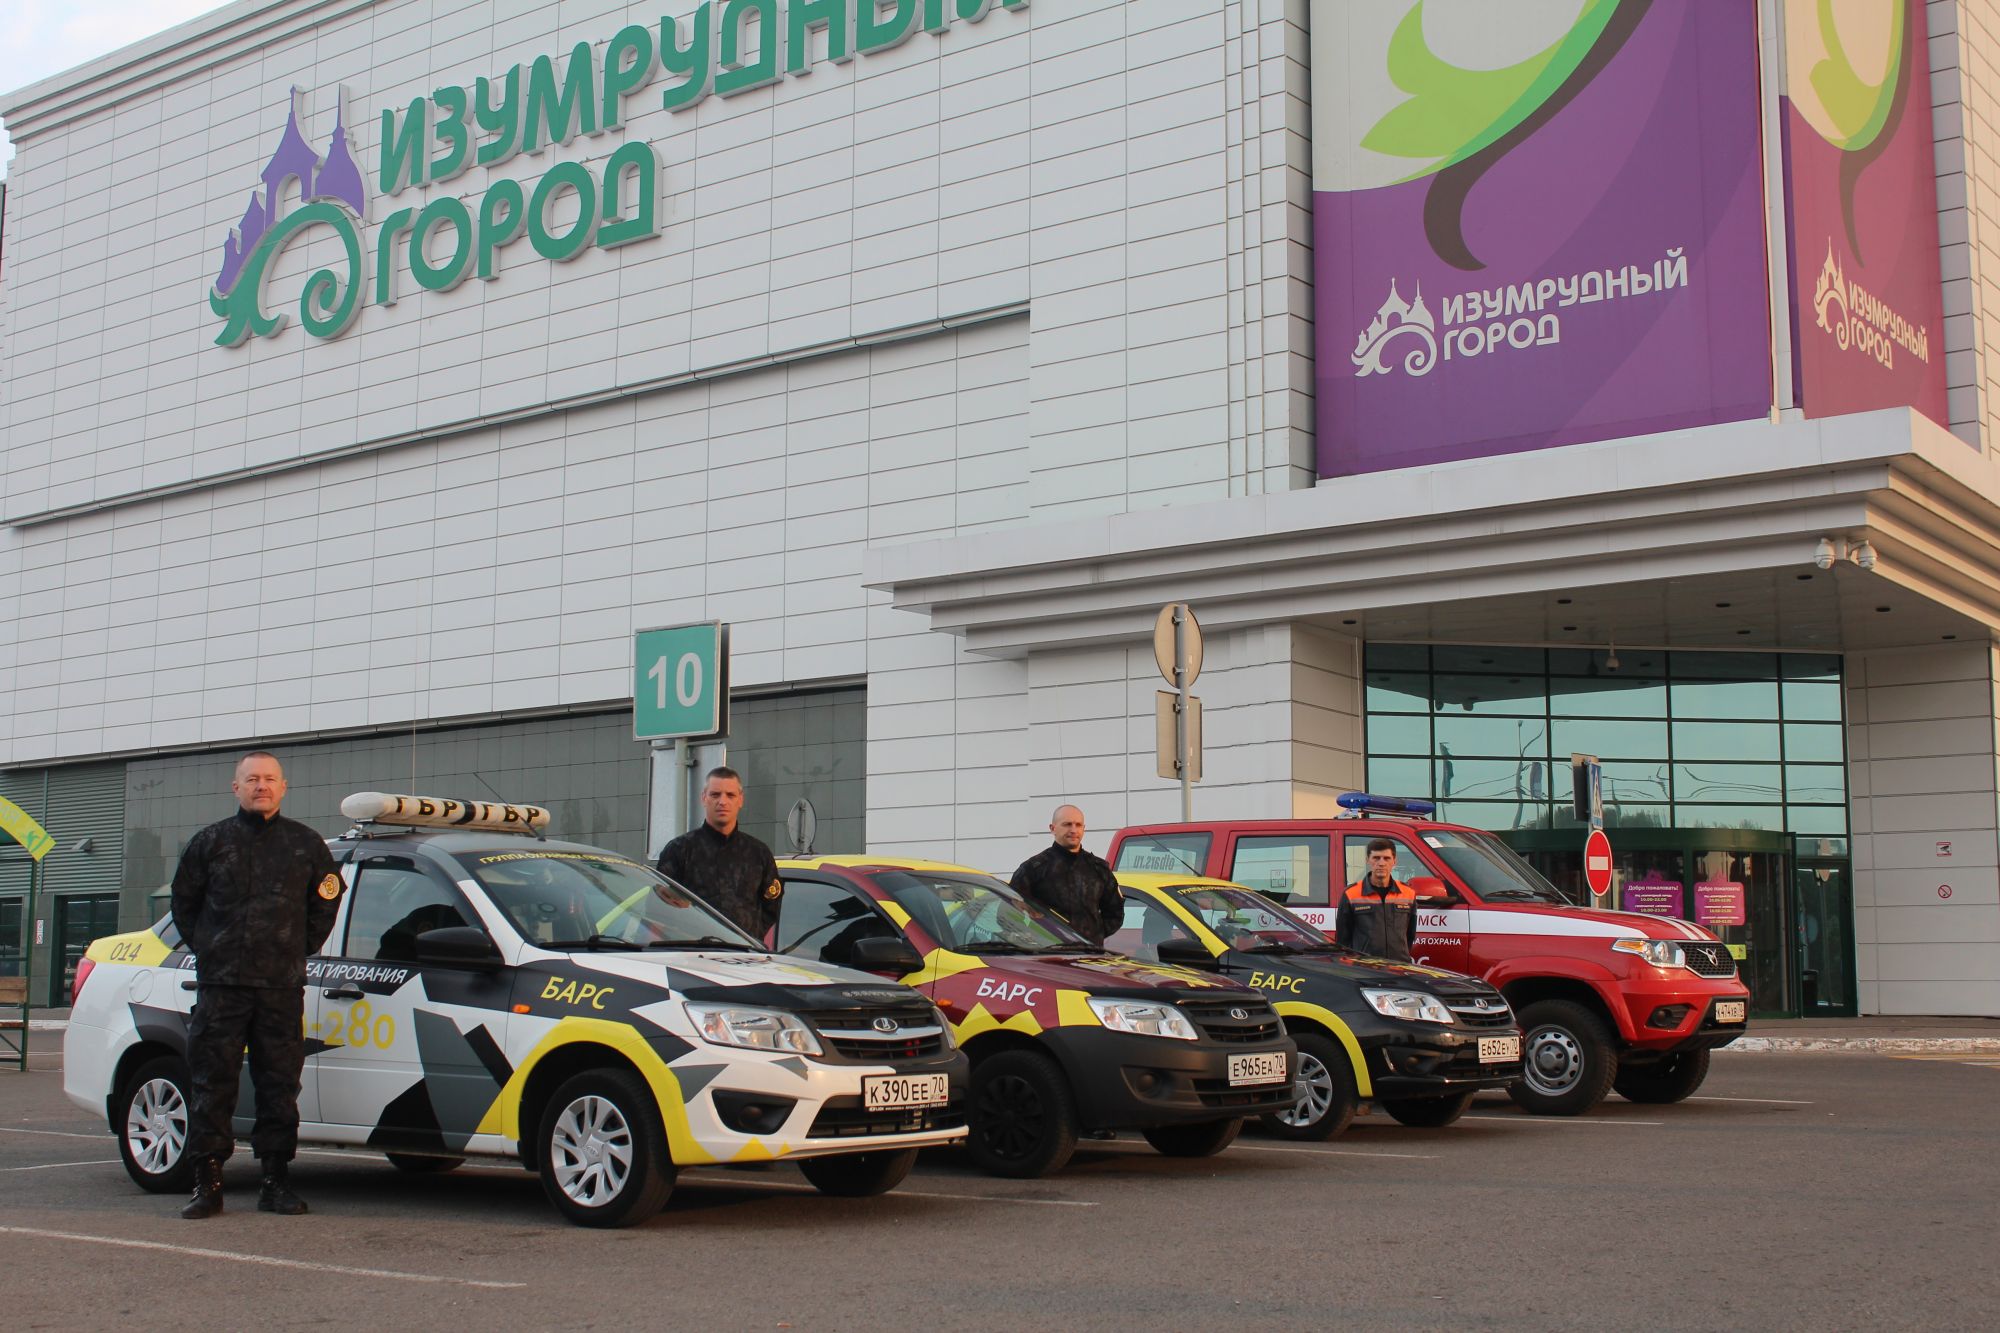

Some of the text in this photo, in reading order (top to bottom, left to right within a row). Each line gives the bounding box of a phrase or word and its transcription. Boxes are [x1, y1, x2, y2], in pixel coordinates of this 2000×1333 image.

[376, 140, 659, 307] ГОРОД
[1442, 246, 1689, 326] ИЗУМРУДНЫЙ
[1443, 313, 1560, 361] ГОРОД
[1848, 279, 1929, 365] ИЗУМРУДНЫЙ
[1851, 316, 1894, 370] ГОРОД
[647, 651, 704, 709] 10
[395, 796, 457, 818] ГБР
[479, 853, 526, 864] ГРУППА
[110, 942, 142, 962] 014
[1427, 937, 1461, 946] ОХРАНА
[540, 976, 615, 1010] БАРС
[976, 977, 1043, 1007] БАРС
[1248, 971, 1306, 994] БАРС
[1274, 1055, 1284, 1069] 70
[932, 1076, 944, 1094] 70
